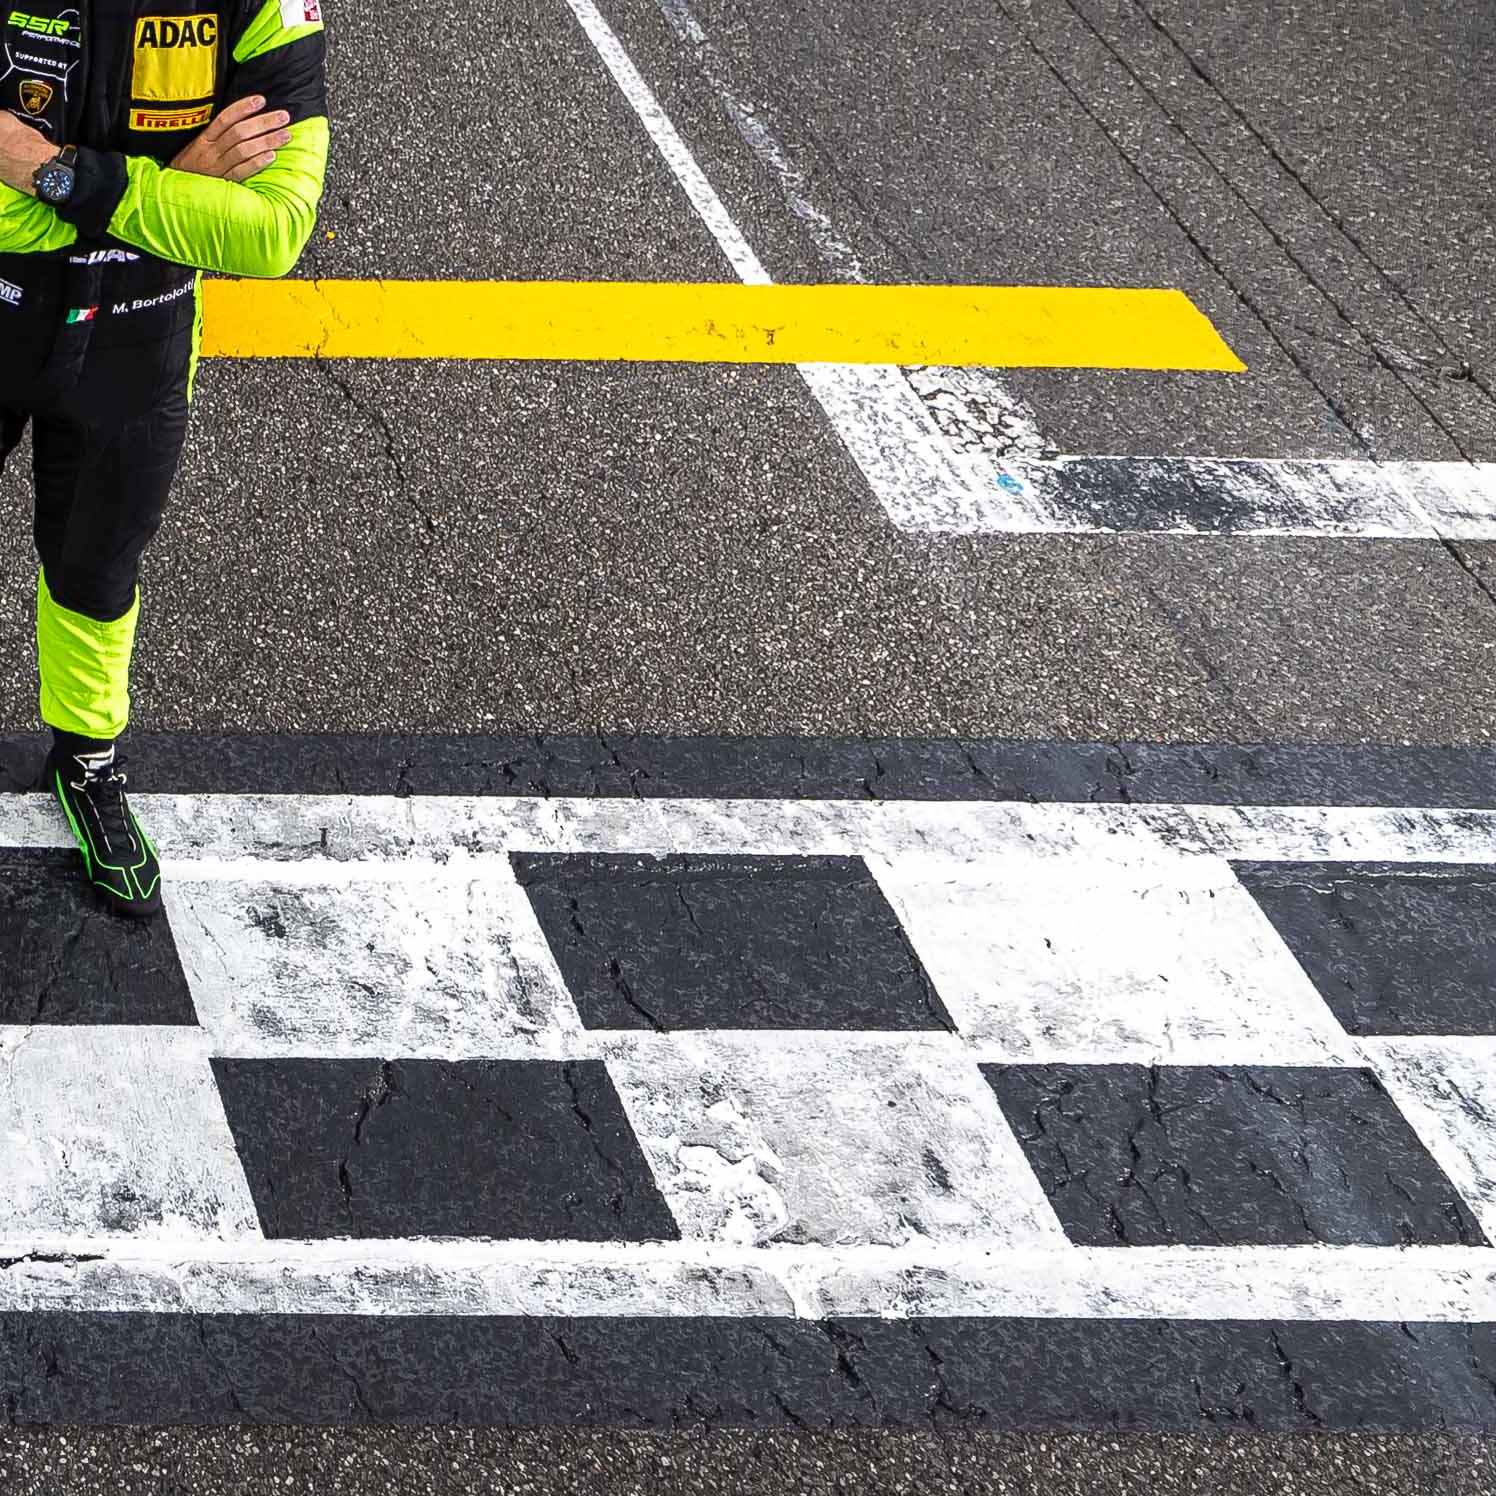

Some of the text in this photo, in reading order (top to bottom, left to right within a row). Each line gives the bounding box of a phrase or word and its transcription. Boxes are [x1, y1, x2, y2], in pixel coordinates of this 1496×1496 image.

[7, 10, 70, 36] SSR
[137, 17, 217, 49] ADAC
[15, 51, 57, 67] SUPPORTED
